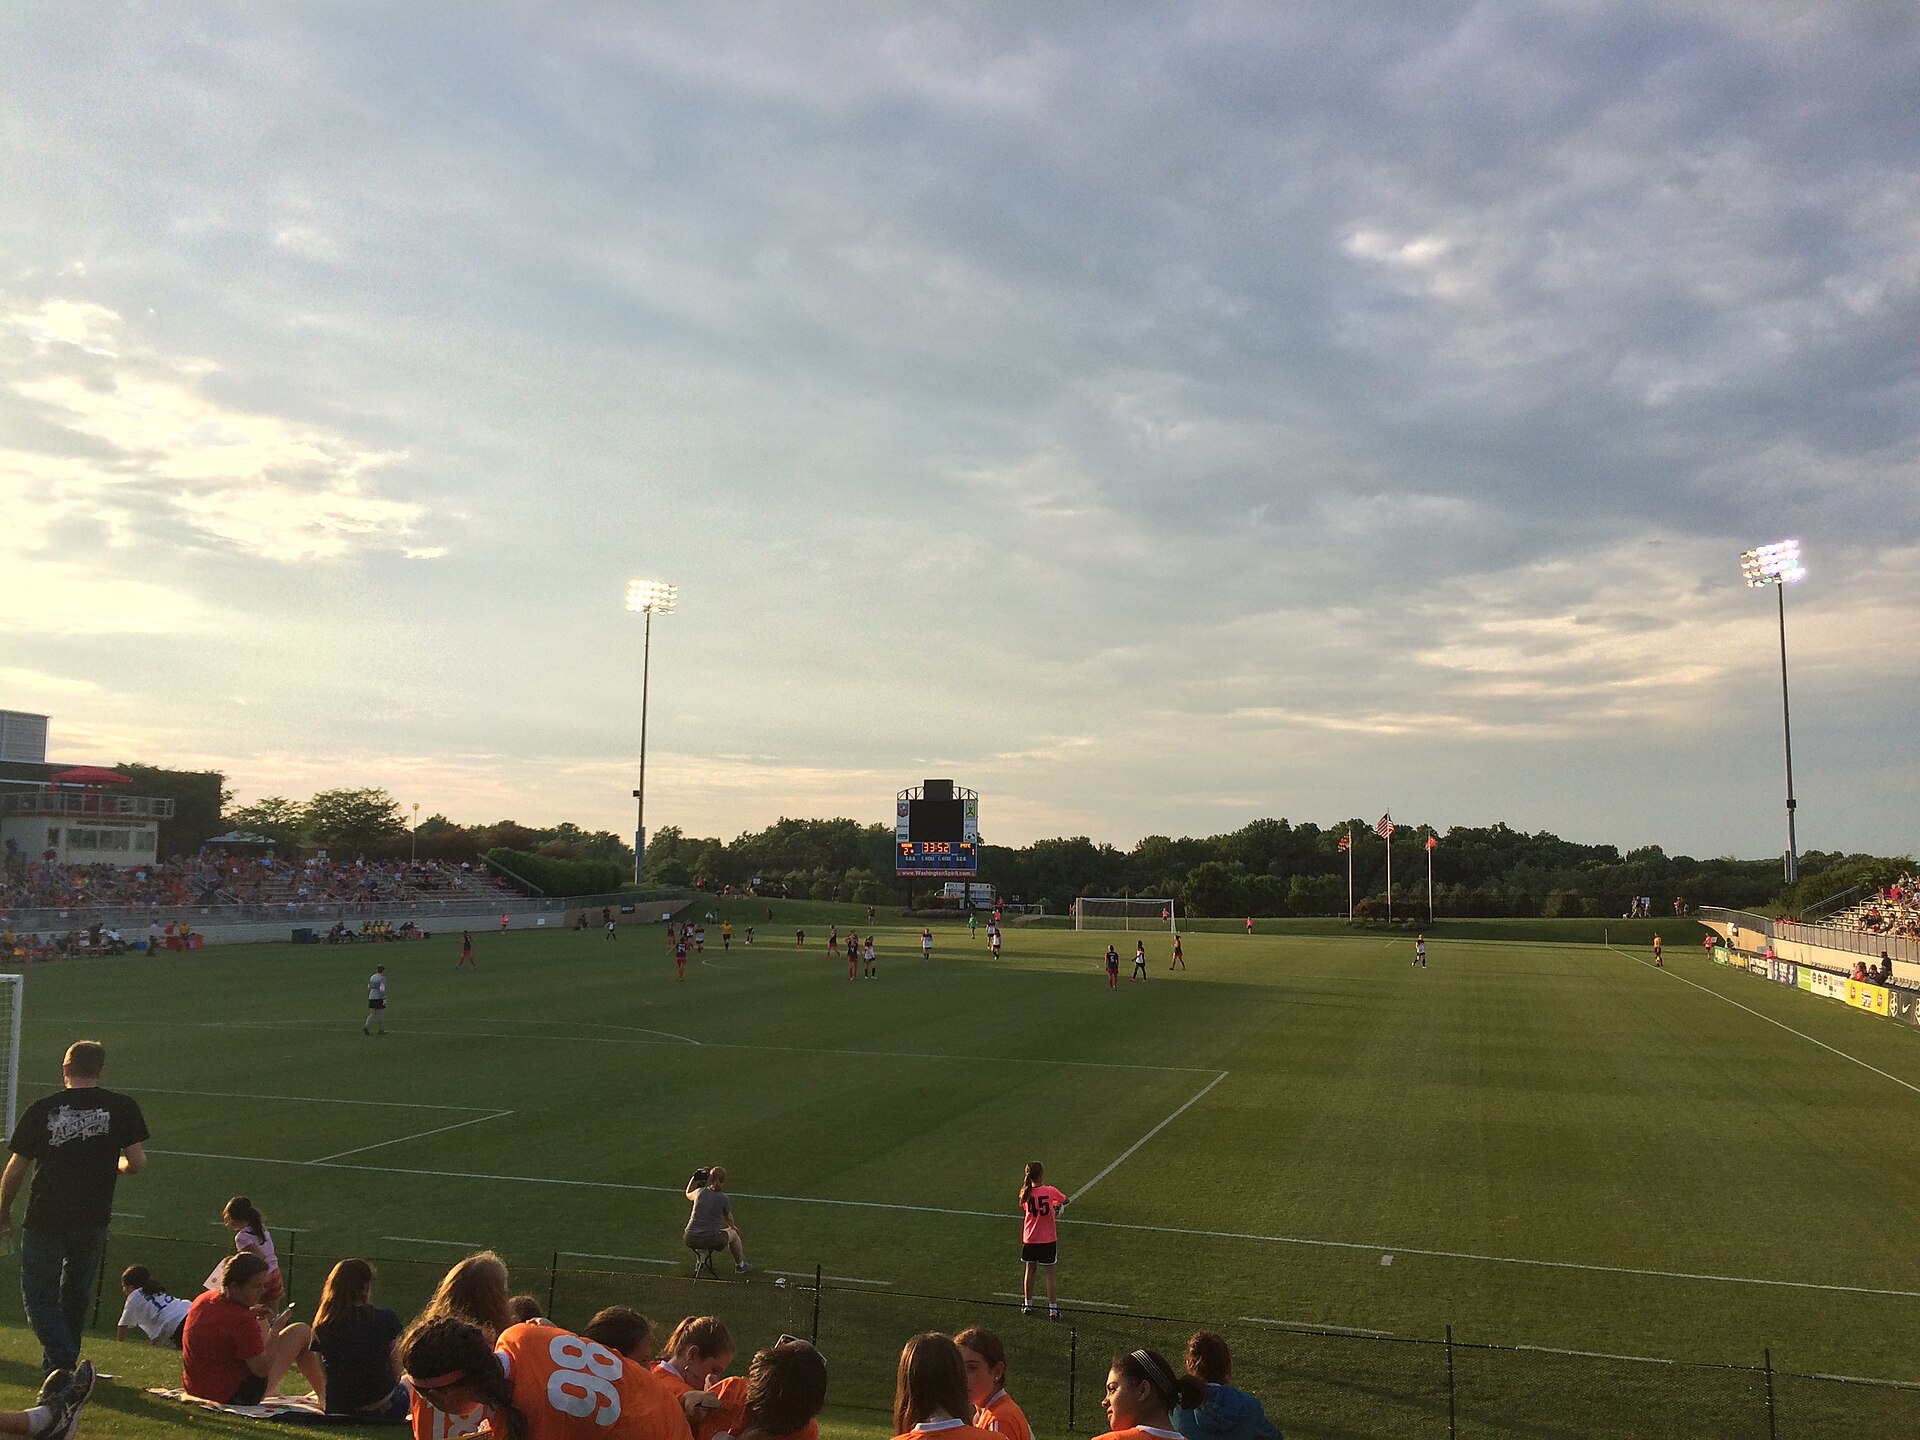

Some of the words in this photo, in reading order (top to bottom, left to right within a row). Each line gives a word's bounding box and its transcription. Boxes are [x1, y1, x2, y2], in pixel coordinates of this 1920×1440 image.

[903, 848, 909, 856] 2
[923, 842, 949, 853] 33:52
[1028, 1195, 1050, 1217] 45
